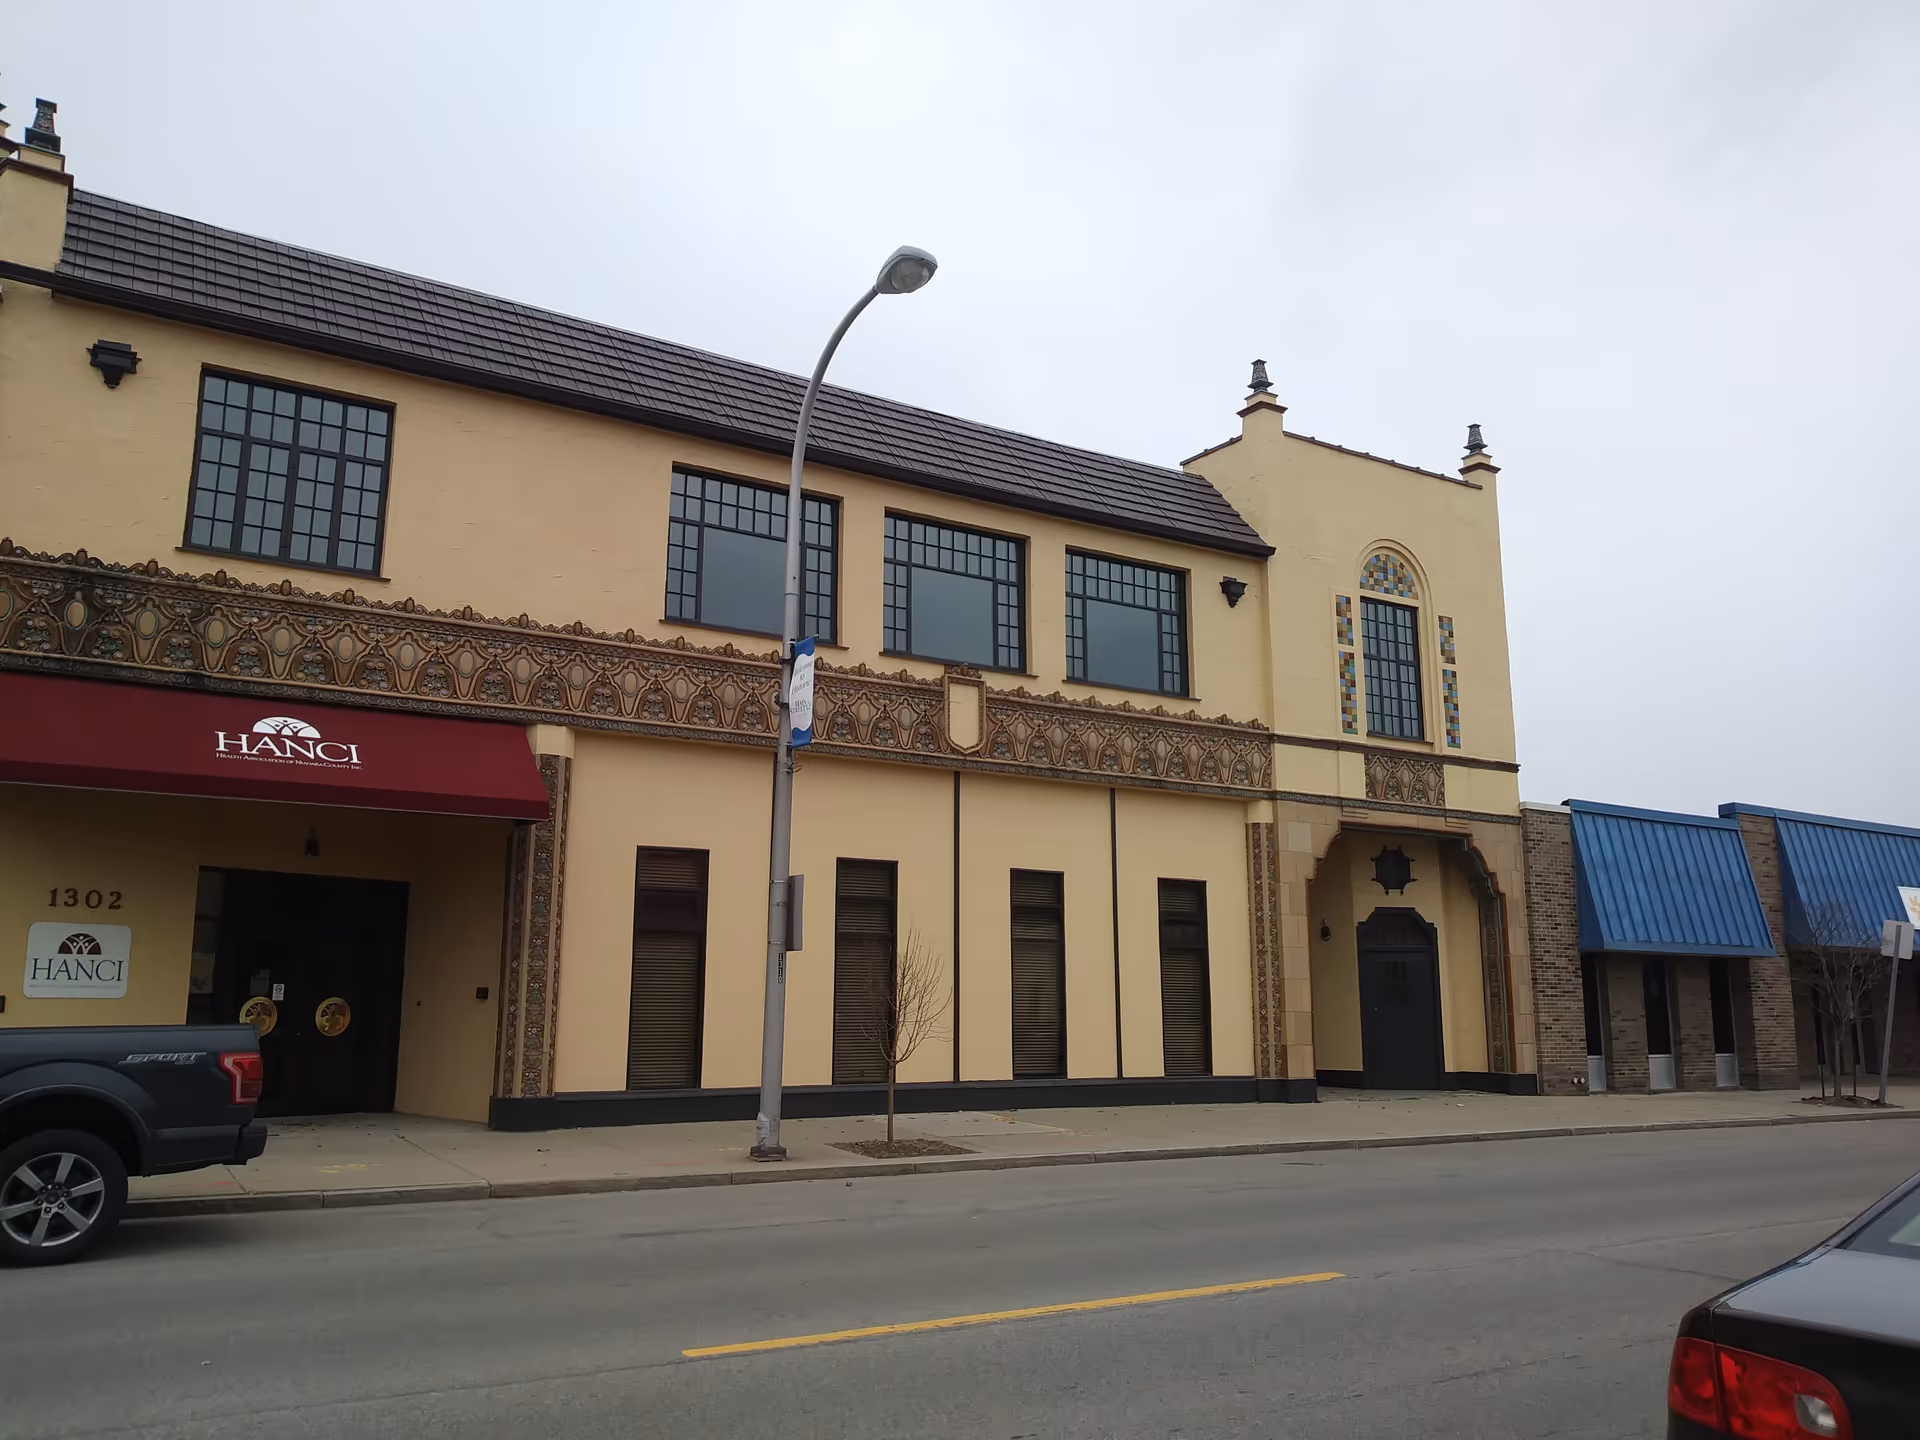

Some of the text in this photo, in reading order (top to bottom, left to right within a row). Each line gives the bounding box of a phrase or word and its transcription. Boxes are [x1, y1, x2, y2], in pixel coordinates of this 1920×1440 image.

[215, 731, 362, 763] HANCI
[48, 888, 123, 910] 1302
[31, 958, 124, 982] HANCI
[118, 1052, 207, 1064] SPORT
